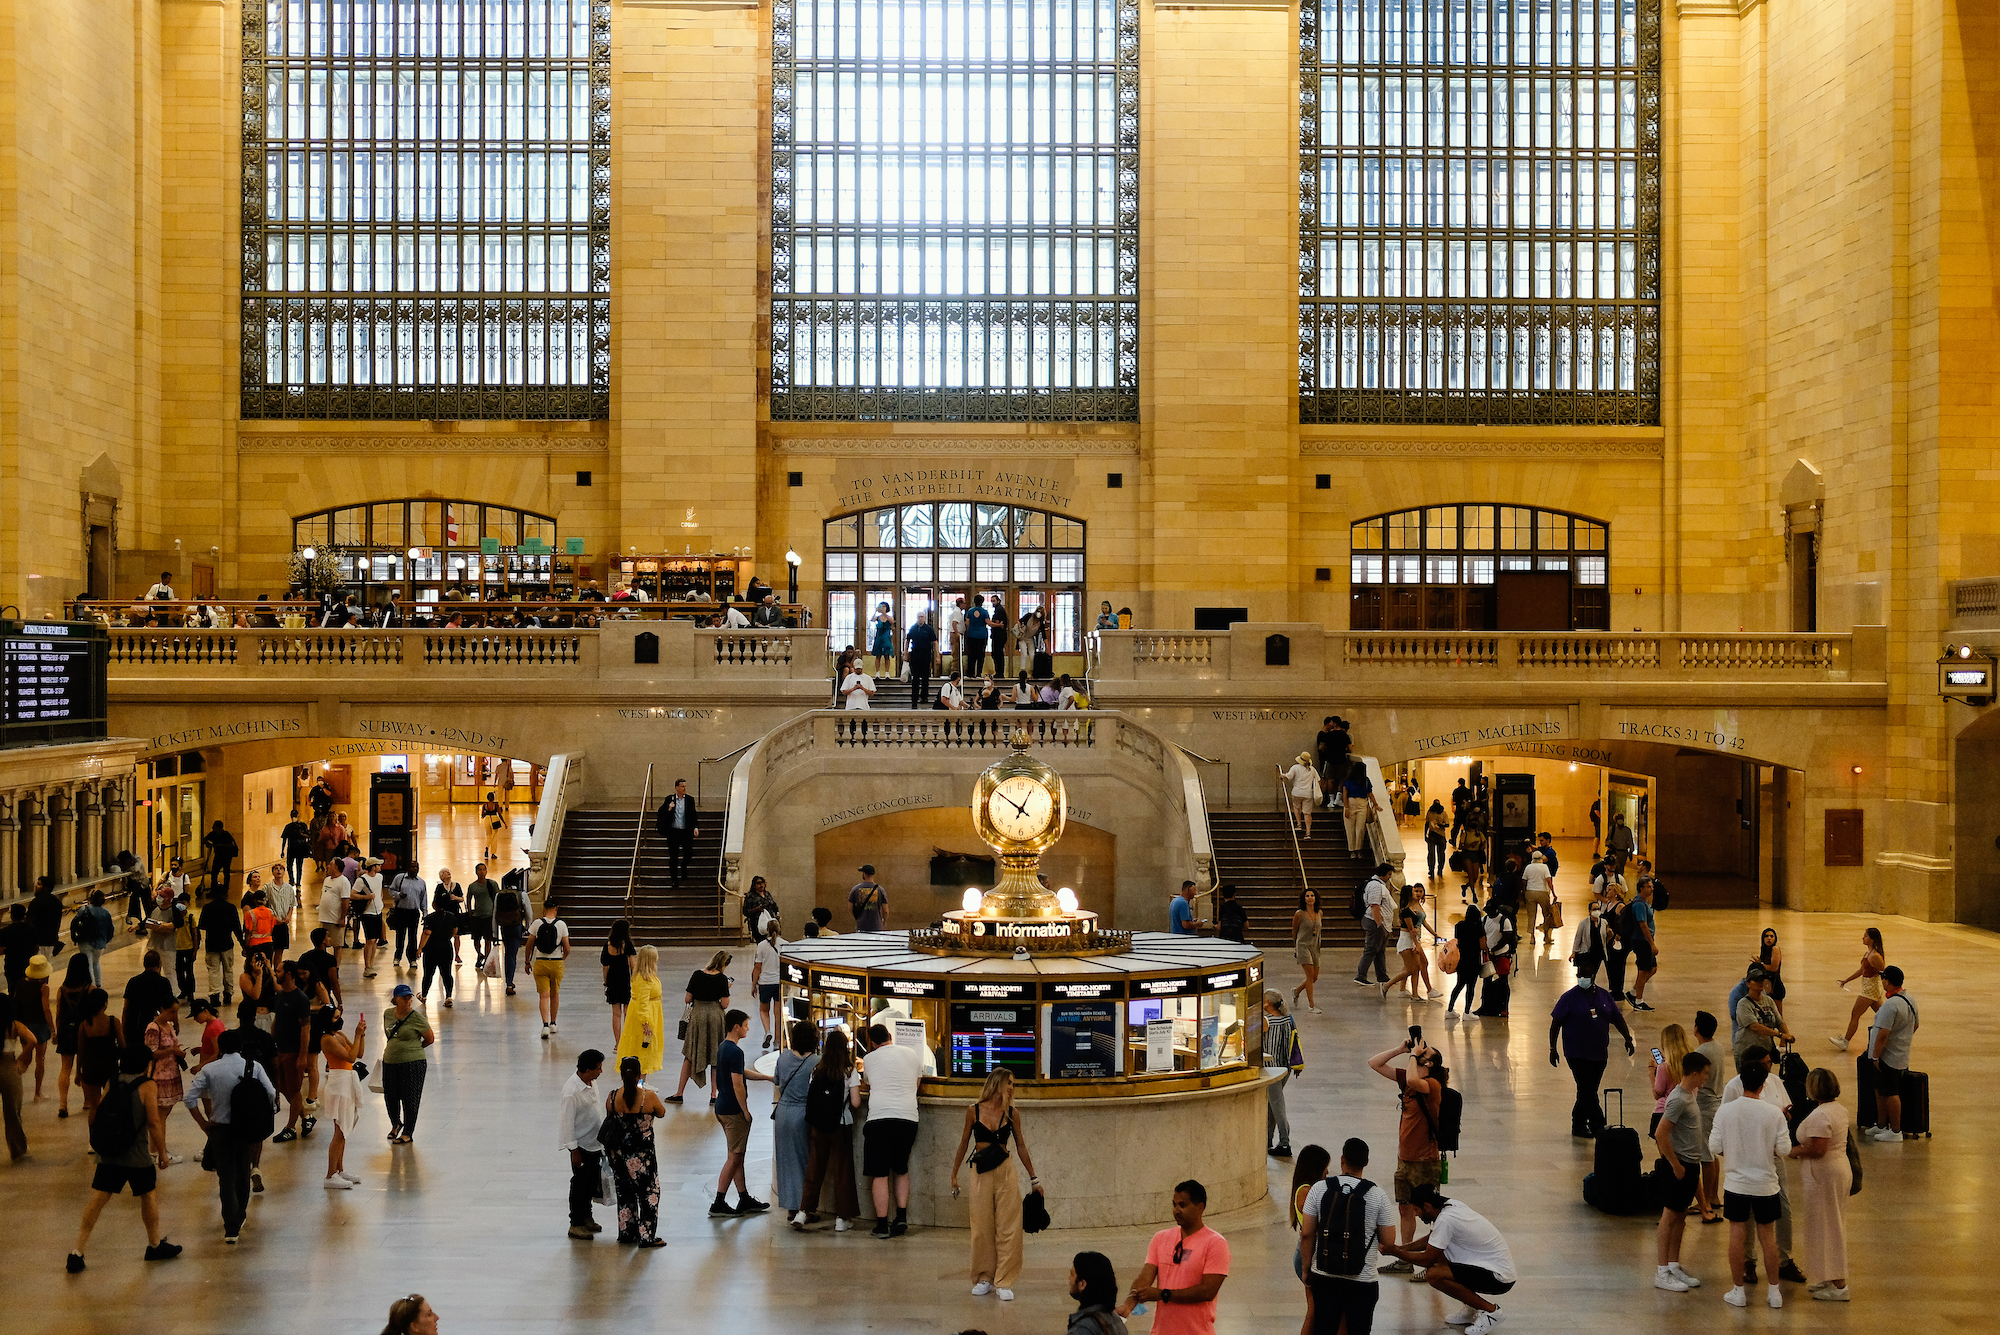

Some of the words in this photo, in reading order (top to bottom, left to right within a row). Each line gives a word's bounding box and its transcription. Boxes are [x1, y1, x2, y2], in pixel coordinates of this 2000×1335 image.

[851, 478, 872, 490] TO
[882, 469, 984, 484] VANDERBILT
[995, 472, 1060, 491] AVENUE
[839, 492, 872, 507] THE
[881, 484, 964, 499] CAMPBELL
[975, 484, 1071, 508] APARTMENT
[418, 547, 431, 558] EXIT
[618, 709, 651, 719] WEST
[655, 709, 713, 719] BALCONY
[1212, 711, 1246, 720] WEST
[1249, 711, 1307, 720] BALCONY
[144, 728, 204, 750] ICKET
[209, 718, 300, 739] MACHINES
[359, 719, 428, 736] SUBWAY
[440, 727, 484, 745] 42ND
[487, 735, 508, 750] ST
[1415, 730, 1470, 751] TICKET
[1478, 721, 1561, 741] MACHINES
[1619, 722, 1681, 739] TRACKS
[1684, 728, 1698, 741] 31
[1704, 730, 1725, 745] TO
[1729, 737, 1745, 750] 42
[329, 741, 388, 756] SUBWAY
[1505, 742, 1566, 756] WAITING
[1572, 747, 1612, 763] ROOM
[821, 805, 864, 826] DINING
[867, 794, 934, 813] CONCOURSE
[1078, 810, 1092, 820] 117
[996, 921, 1071, 937] Information
[895, 981, 934, 990] METRO-NORTH
[973, 1012, 1014, 1020] ARRIVALS
